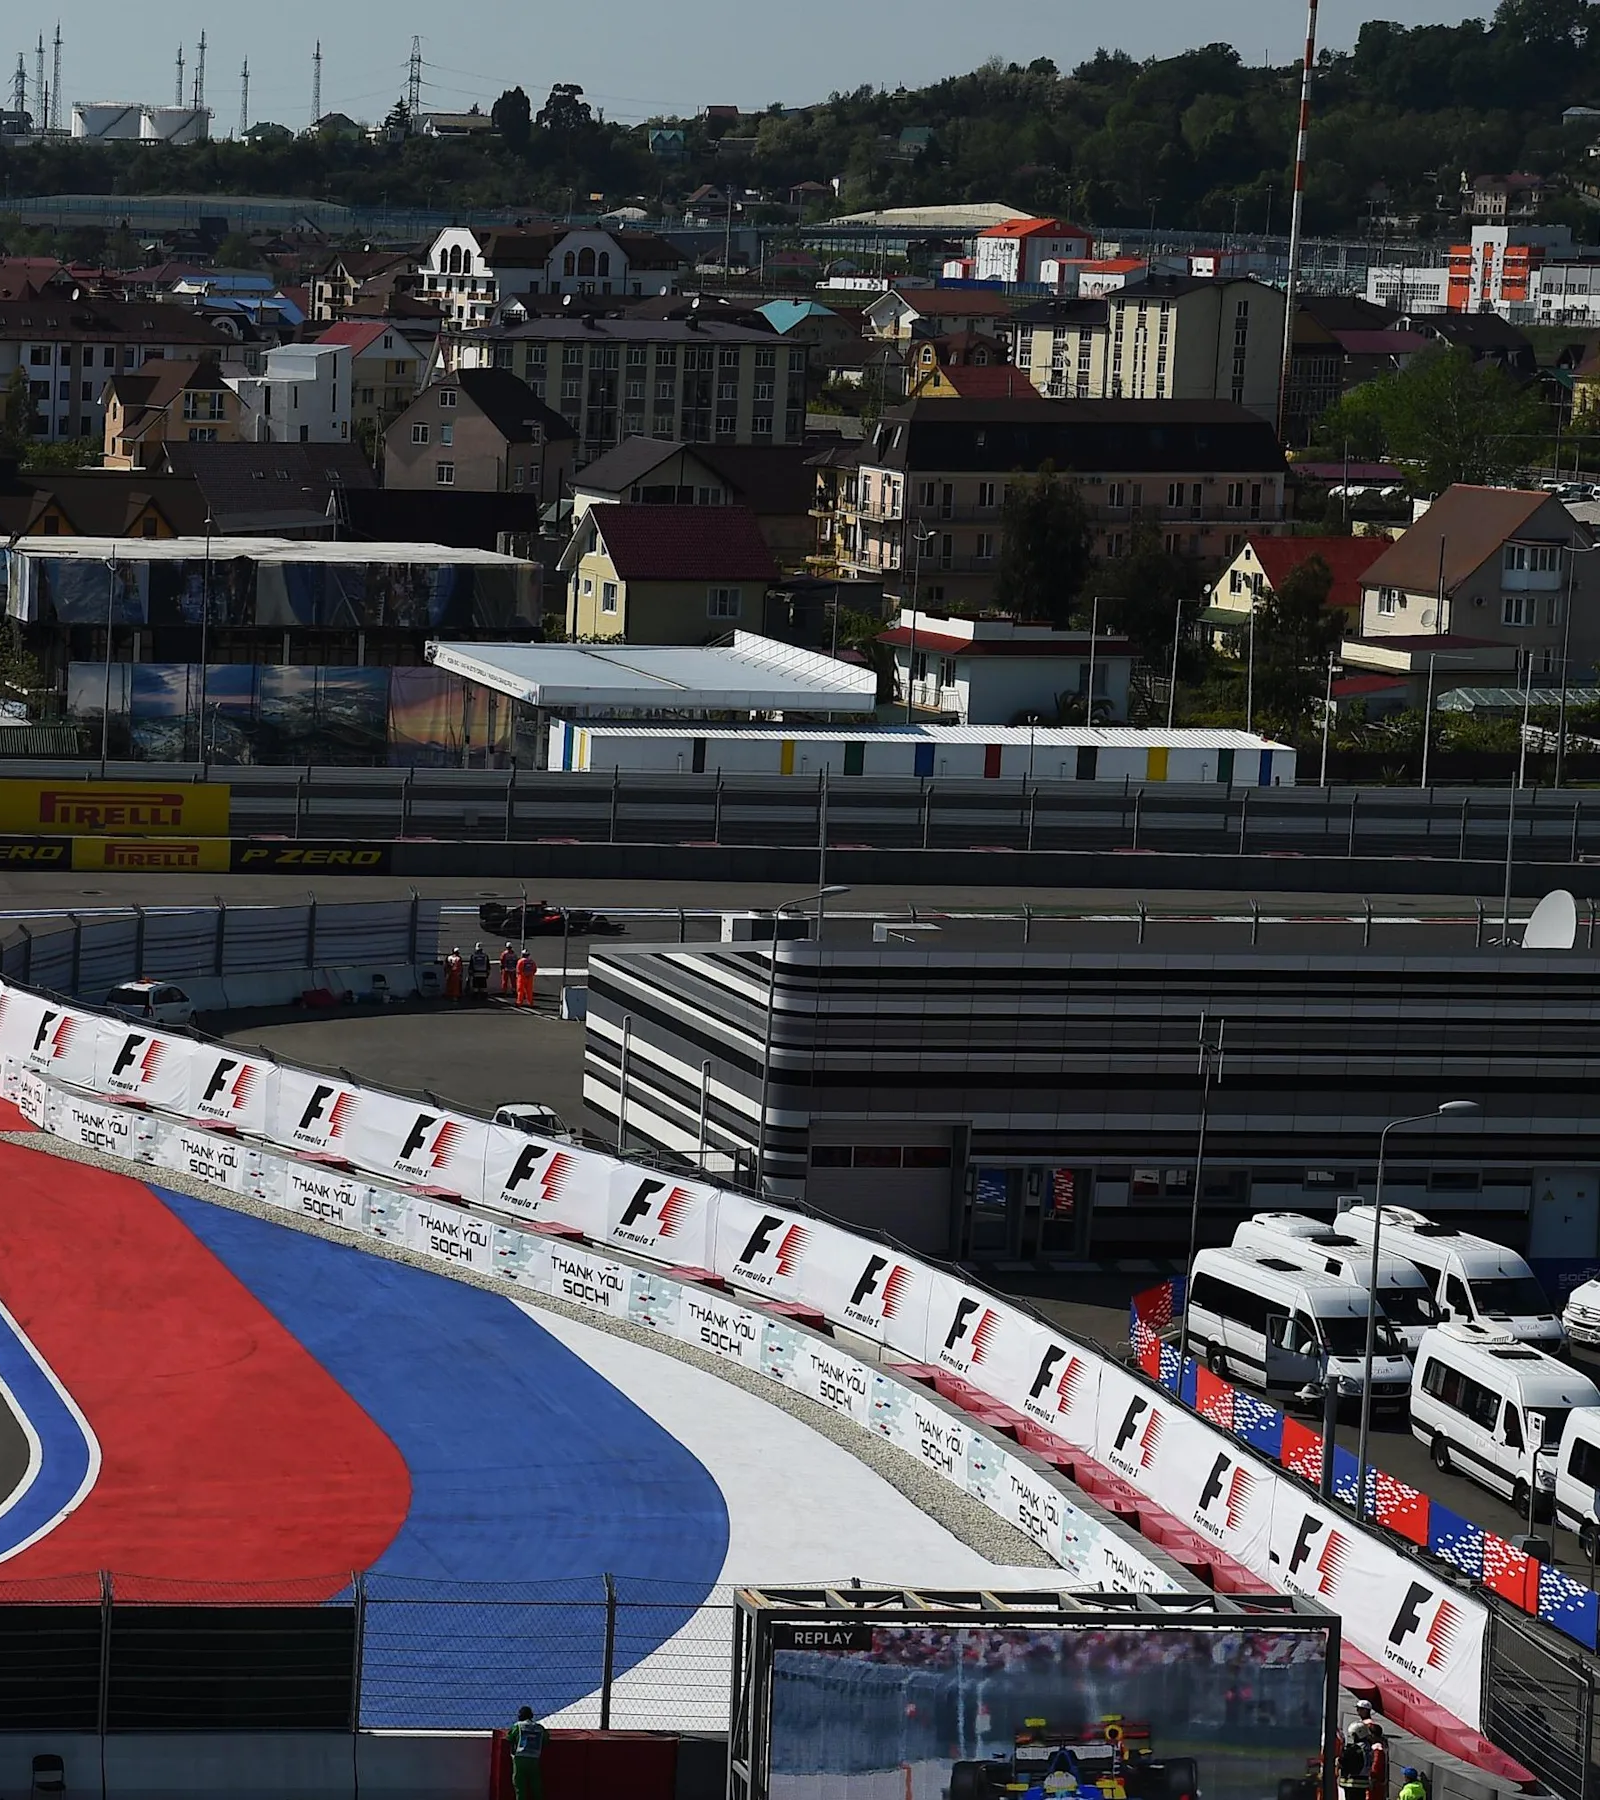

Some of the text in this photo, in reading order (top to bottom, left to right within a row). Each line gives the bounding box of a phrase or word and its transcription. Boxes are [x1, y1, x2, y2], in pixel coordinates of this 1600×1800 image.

[40, 791, 184, 826] PIRELLI
[104, 844, 200, 867] PIRELLI
[240, 848, 382, 865] P ZERO
[34, 1010, 81, 1058] F1
[112, 1034, 171, 1083] F1
[108, 1077, 133, 1091] Formula
[203, 1058, 263, 1110] F1
[72, 1110, 128, 1136] THANK YOU
[198, 1103, 224, 1116] Formula
[299, 1085, 363, 1138] F1
[81, 1128, 116, 1149] SOCHI
[293, 1131, 320, 1146] Formula
[399, 1114, 470, 1170] F1
[181, 1140, 238, 1168] THANK YOU
[394, 1160, 421, 1177] Formula
[190, 1160, 226, 1182] SOCHI
[505, 1144, 581, 1201] F1
[292, 1176, 356, 1206] THANK YOU
[500, 1192, 530, 1209] Formula
[304, 1197, 343, 1221] SOCHI
[620, 1178, 698, 1238] F1
[419, 1214, 487, 1247] THANK YOU
[613, 1227, 646, 1244] Formula
[431, 1237, 472, 1262] SOCHI
[740, 1215, 816, 1277] F1
[552, 1256, 624, 1291] THANK YOU
[732, 1264, 764, 1283] Formula
[850, 1255, 915, 1320] F1
[564, 1281, 609, 1306] SOCHI
[688, 1303, 756, 1340] THANK YOU
[844, 1306, 872, 1326] Formula
[944, 1297, 1004, 1364] F1
[701, 1330, 742, 1356] SOCHI
[811, 1355, 866, 1395] THANK YOU
[939, 1350, 963, 1371] Formula
[1030, 1344, 1088, 1416] F1
[820, 1382, 852, 1412] SOCHI
[1024, 1399, 1049, 1422] Formula
[914, 1413, 963, 1456] THANK YOU
[1114, 1394, 1168, 1470] F1
[922, 1440, 953, 1473] SOCHI
[1109, 1451, 1132, 1475] Formula
[1011, 1476, 1058, 1526] THANK YOU
[1198, 1452, 1259, 1531] F1
[1194, 1511, 1218, 1536] Formula
[1104, 1548, 1137, 1588] THANK
[1289, 1514, 1355, 1597] F1
[794, 1632, 852, 1644] REPLAY
[1389, 1581, 1467, 1672] F1
[1384, 1645, 1415, 1675] Formula
